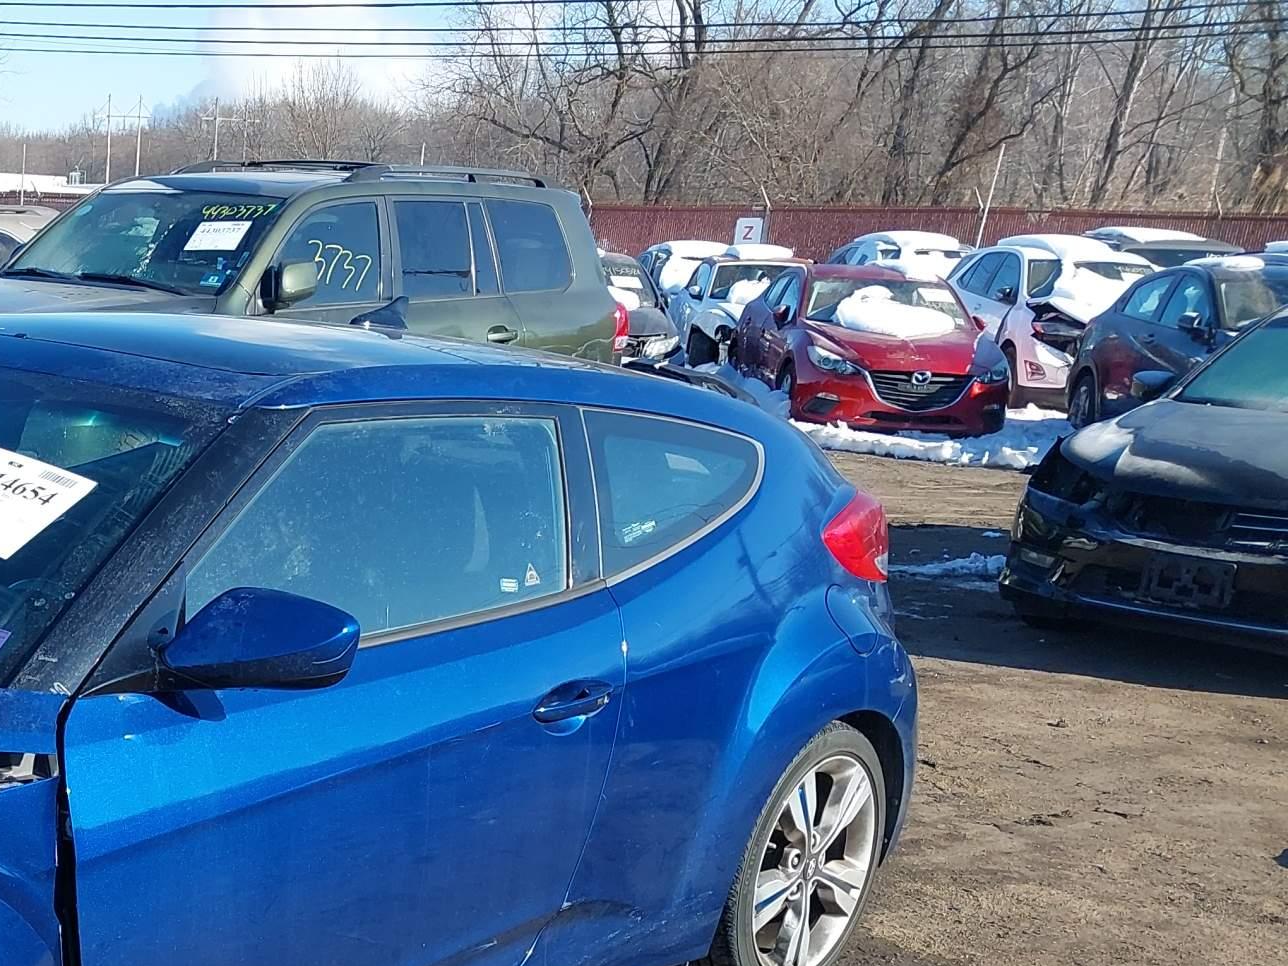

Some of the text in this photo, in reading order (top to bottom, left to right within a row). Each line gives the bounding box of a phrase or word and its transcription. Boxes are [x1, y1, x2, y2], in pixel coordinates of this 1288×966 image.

[202, 203, 278, 220] 44303737
[742, 225, 755, 241] Z
[308, 240, 372, 292] 3737
